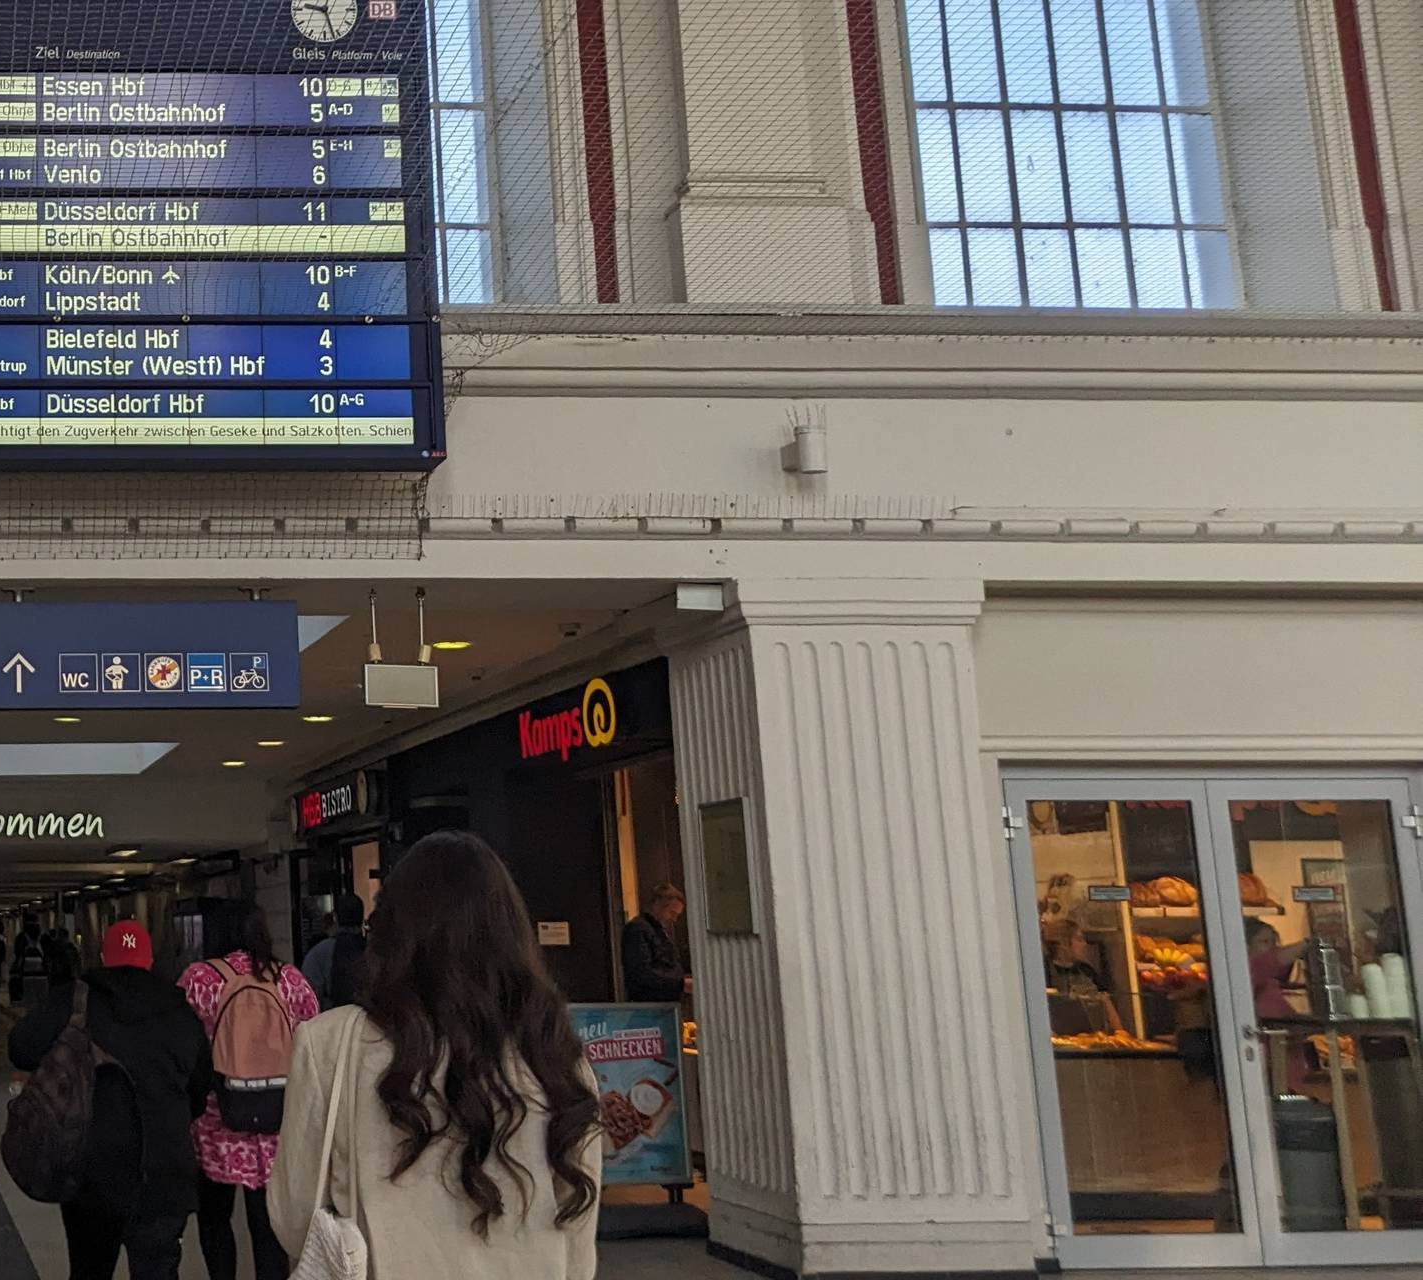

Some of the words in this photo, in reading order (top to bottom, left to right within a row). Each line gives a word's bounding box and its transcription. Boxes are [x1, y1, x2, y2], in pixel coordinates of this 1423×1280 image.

[371, 3, 393, 16] DB
[35, 46, 59, 59] Ziel
[67, 48, 120, 60] Destination
[292, 47, 326, 60] Gleis
[332, 50, 373, 60] Platform
[382, 51, 402, 60] Voie
[43, 76, 103, 96] Essen
[112, 76, 145, 97] Hbf
[299, 78, 322, 97] 10
[3, 106, 34, 116] Ohne
[43, 103, 99, 122] Berlin
[109, 104, 225, 123] Ostbahnhof
[311, 104, 323, 122] 5
[329, 104, 353, 115] A-D
[44, 139, 100, 158] Berlin
[110, 140, 226, 159] Ostbahnhof
[10, 168, 32, 180] Hbf
[44, 165, 101, 184] Venlo
[313, 166, 325, 184] 6
[45, 200, 156, 222] Düsseldorf
[165, 202, 199, 222] Hbf
[303, 202, 325, 221] 11
[45, 228, 102, 246] Berlin
[111, 228, 228, 247] Ostbahnhof
[45, 265, 152, 285] Köln/Bonn
[306, 266, 329, 285] 10
[335, 266, 357, 277] B-F
[45, 293, 140, 313] Lippstadt
[318, 293, 330, 311] 4
[46, 329, 137, 350] Bielefeld
[145, 329, 179, 350] Hbf
[319, 330, 332, 348] 4
[46, 357, 134, 376] Münster
[143, 357, 222, 376] (Westf)
[231, 357, 265, 376] Hbf
[320, 358, 333, 376] 3
[46, 394, 160, 414] Düsseldorf
[169, 394, 204, 414] Hbf
[309, 395, 334, 414] 10
[340, 395, 364, 407] A-G
[37, 425, 60, 437] den
[64, 425, 138, 441] Zugverkehr
[144, 425, 205, 438] zwischen
[210, 426, 257, 438] Geseke
[262, 425, 285, 438] und
[290, 425, 365, 438] Salzkotten.
[369, 425, 411, 438] Schien
[254, 656, 262, 668] P
[62, 672, 89, 687] WC
[190, 669, 223, 685] P+R
[519, 707, 583, 762] Kamps
[321, 784, 352, 818] BISTRO
[578, 1022, 607, 1040] neu
[588, 1039, 662, 1060] SCHNECKEN
